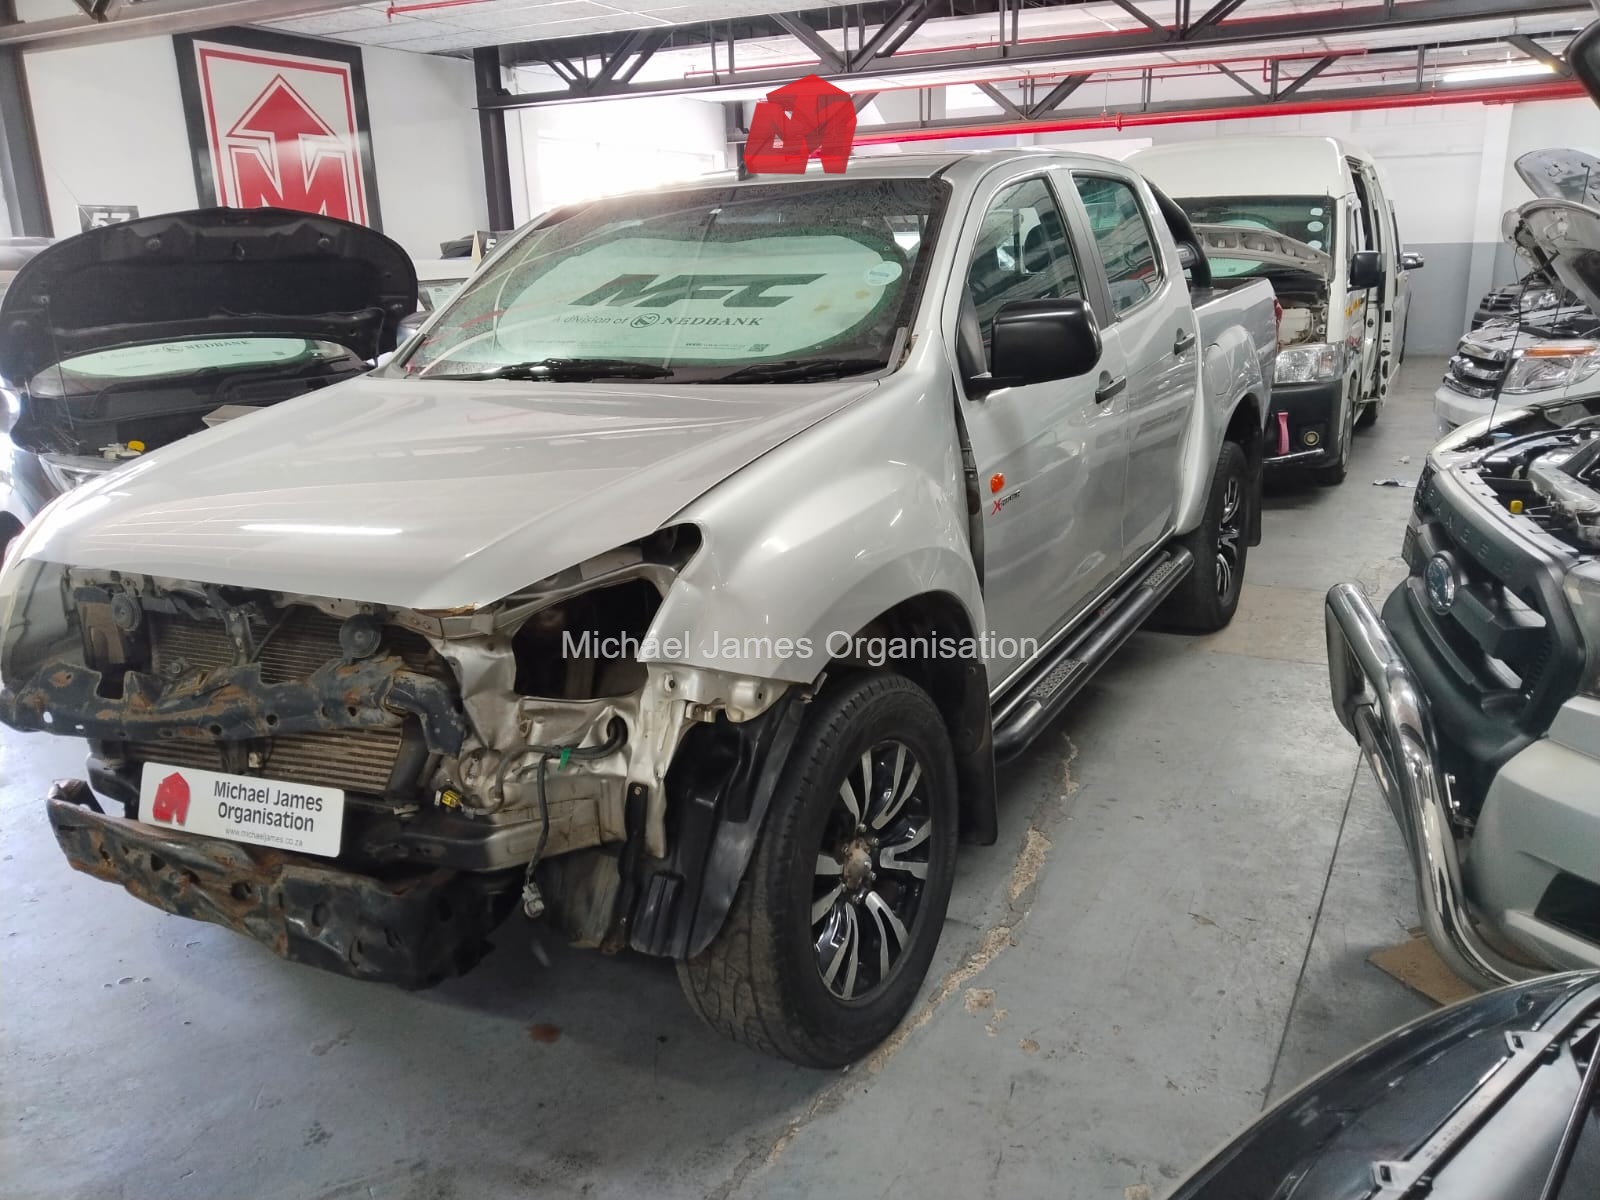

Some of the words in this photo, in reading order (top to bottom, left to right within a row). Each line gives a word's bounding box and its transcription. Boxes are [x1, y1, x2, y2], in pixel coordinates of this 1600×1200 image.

[568, 273, 827, 308] MFC
[563, 315, 612, 325] division
[613, 316, 630, 325] of
[660, 316, 764, 327] NEDBANK
[213, 780, 270, 805] Michael
[273, 789, 324, 813] James
[218, 801, 315, 833] Organisation
